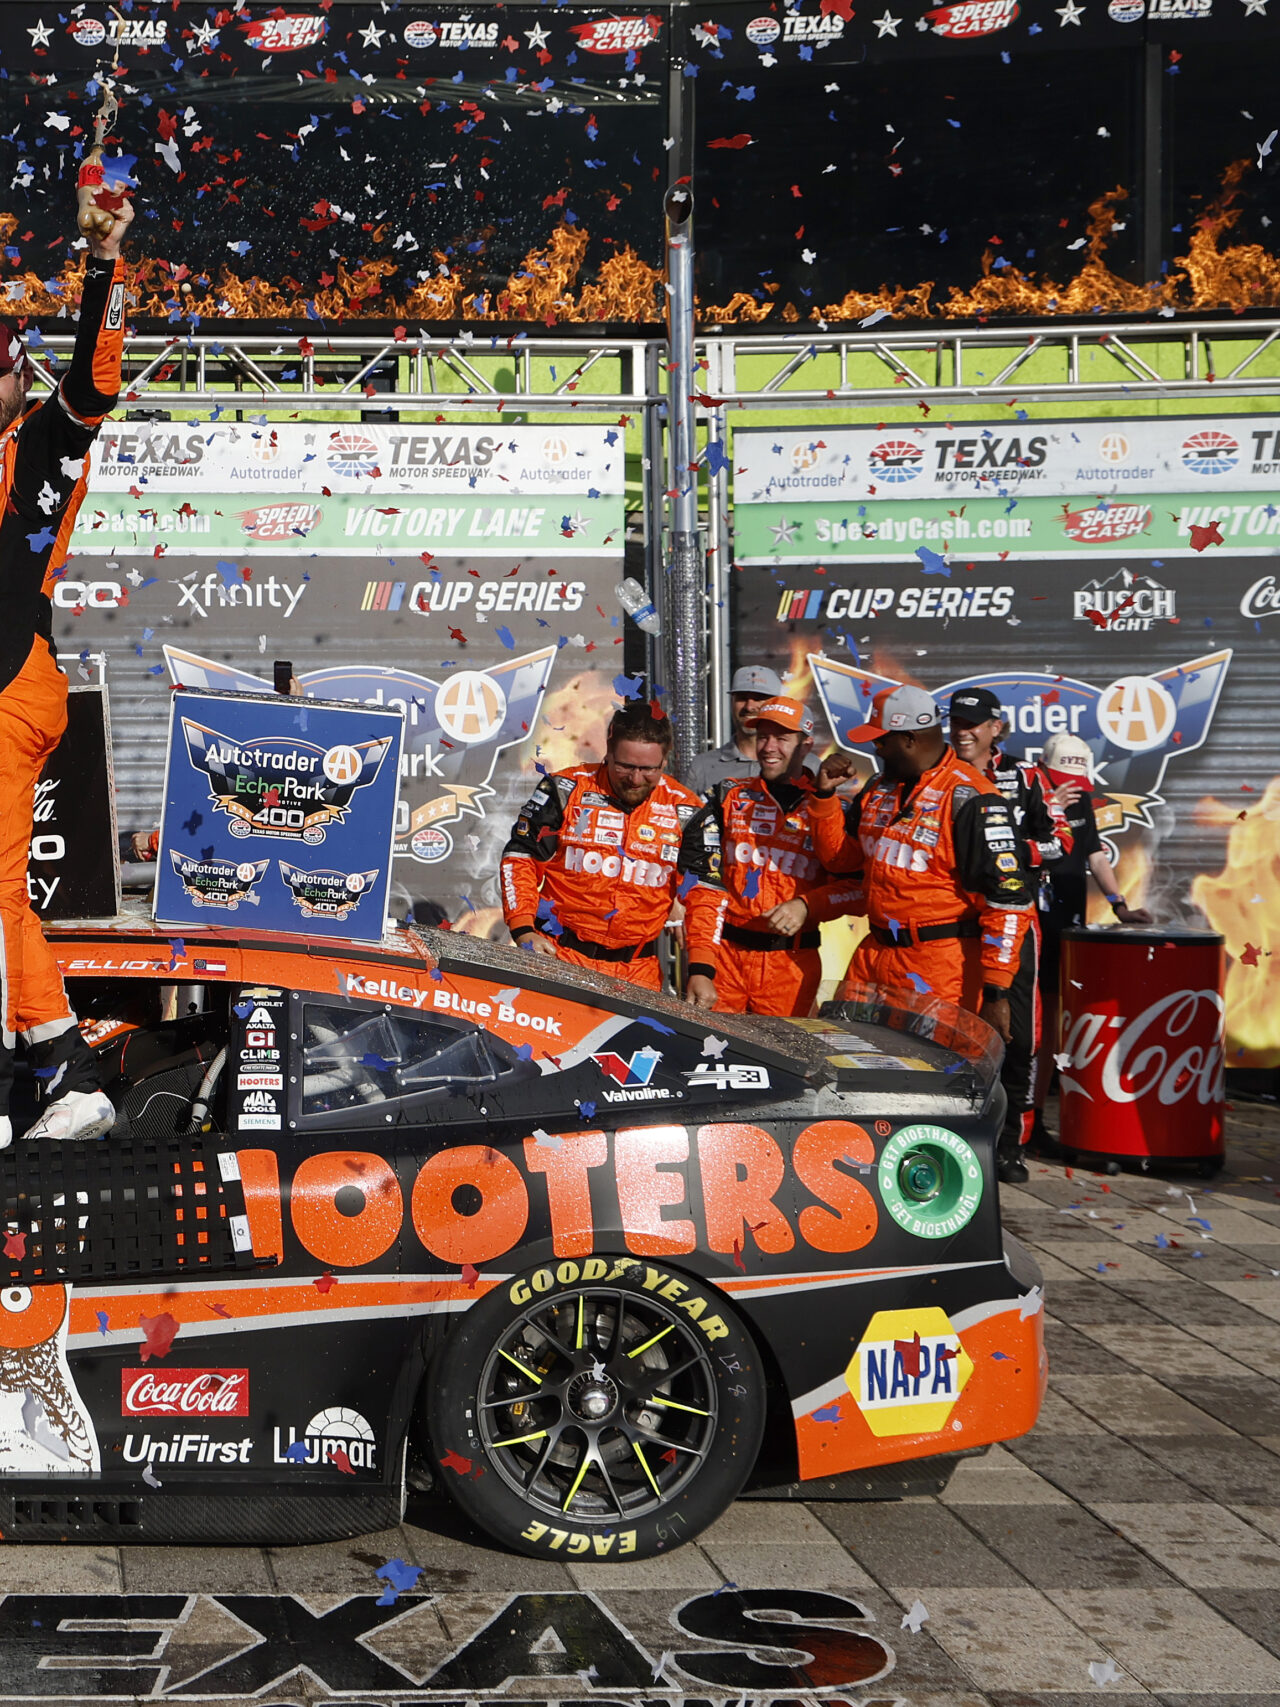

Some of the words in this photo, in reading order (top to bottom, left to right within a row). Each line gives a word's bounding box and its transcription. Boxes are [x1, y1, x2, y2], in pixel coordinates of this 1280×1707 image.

[951, 0, 1018, 23] SPEEDY
[1147, 0, 1213, 11] TEXAS
[107, 20, 167, 38] TEXAS
[260, 16, 325, 36] SPEDY
[440, 22, 499, 41] TEXAS
[782, 14, 843, 36] TEXAS
[467, 40, 498, 48] PEEDWAY
[782, 34, 808, 43] MOTOR
[810, 32, 843, 42] SPEEDWAY
[98, 434, 205, 466] TEXAS
[389, 436, 495, 465] TEXAS
[935, 436, 1048, 470] TEXAS
[98, 465, 140, 478] MOTOR
[141, 465, 202, 479] SPEEDWAY
[230, 465, 303, 482] Autotrader
[389, 466, 431, 478] MOTOR
[431, 466, 490, 480] SPEEDWAY
[520, 467, 592, 482] Autotrader
[934, 472, 978, 482] MOTOR
[980, 469, 1046, 482] SPEEDWAY
[1075, 466, 1154, 483] Autotrader
[767, 475, 843, 490] Autotrader
[257, 504, 320, 524] SPEEDY
[344, 507, 466, 537] VICTORY
[467, 507, 546, 537] LANE
[1079, 504, 1151, 529] SPEEDY
[177, 573, 307, 619] xfinity
[409, 581, 474, 612] CUP
[475, 581, 587, 612] SERIES
[825, 588, 896, 620] CUP
[895, 586, 1015, 619] SERIES
[1073, 588, 1176, 621] BUSCH
[889, 714, 907, 728] 9
[204, 742, 320, 774] Autotrader
[234, 774, 328, 802] EchoPark
[251, 806, 305, 829] 400
[639, 829, 654, 839] NAPA
[180, 861, 235, 876] Autotrader
[564, 846, 674, 889] HOOTERS
[194, 876, 238, 890] EchoPark
[289, 872, 345, 888] Autotrader
[203, 890, 229, 903] 400
[303, 887, 348, 902] EchoPark
[312, 901, 337, 913] 400
[67, 959, 189, 972] ELLIOTT
[346, 970, 428, 1008] Kelley
[432, 988, 494, 1019] Blue
[498, 1003, 564, 1037] Book
[247, 1031, 274, 1047] CI
[239, 1078, 280, 1086] HOOTERS
[242, 1091, 276, 1107] MAC
[600, 1083, 674, 1104] Valvoline
[242, 1118, 277, 1126] SIEMENS
[882, 1146, 899, 1170] GET
[890, 1198, 913, 1229] GET
[911, 1190, 980, 1238] BIOETHANOL
[509, 1256, 730, 1344] GOODYEAR
[866, 1342, 952, 1402] NAPA
[125, 1372, 246, 1413] Coca-Cola
[122, 1433, 254, 1464] UniFirst
[520, 1519, 638, 1557] EAGLE
